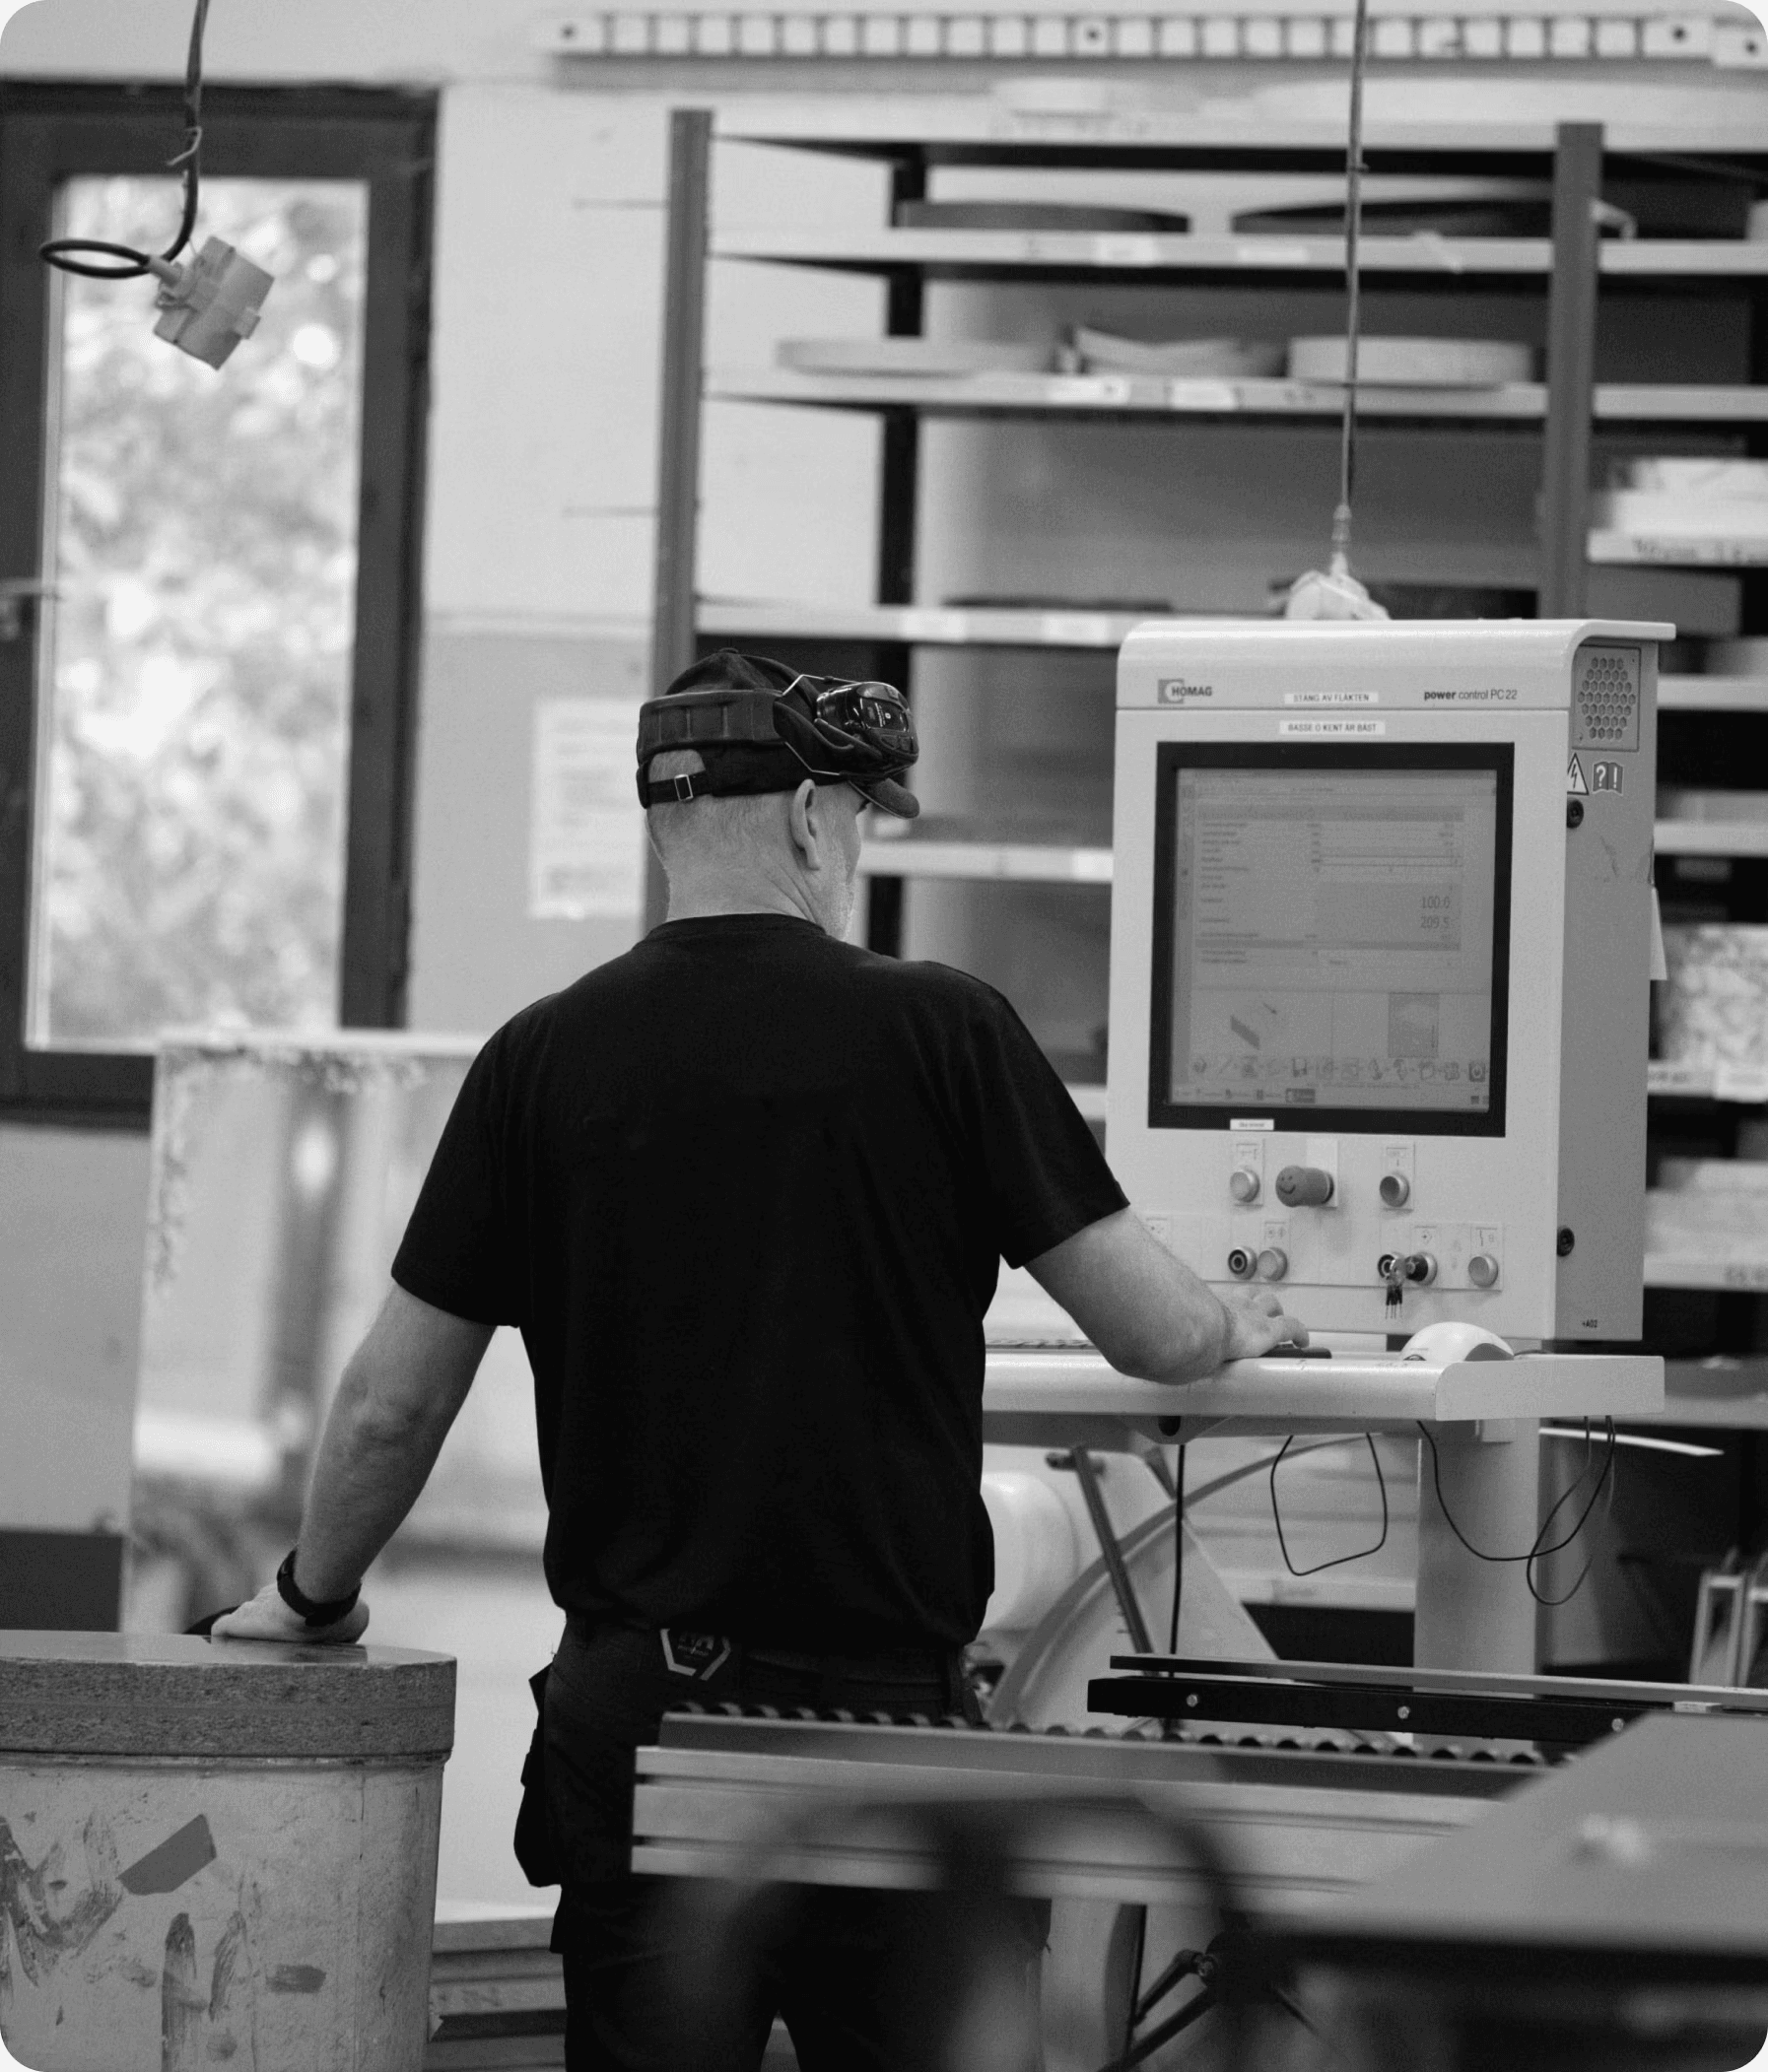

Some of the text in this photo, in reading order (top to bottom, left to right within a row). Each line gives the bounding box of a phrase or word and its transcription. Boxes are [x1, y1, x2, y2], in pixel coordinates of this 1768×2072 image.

[1171, 685, 1213, 697] HOMAG
[1423, 691, 1457, 702] power
[1459, 690, 1488, 701] control
[1322, 693, 1333, 702] AV
